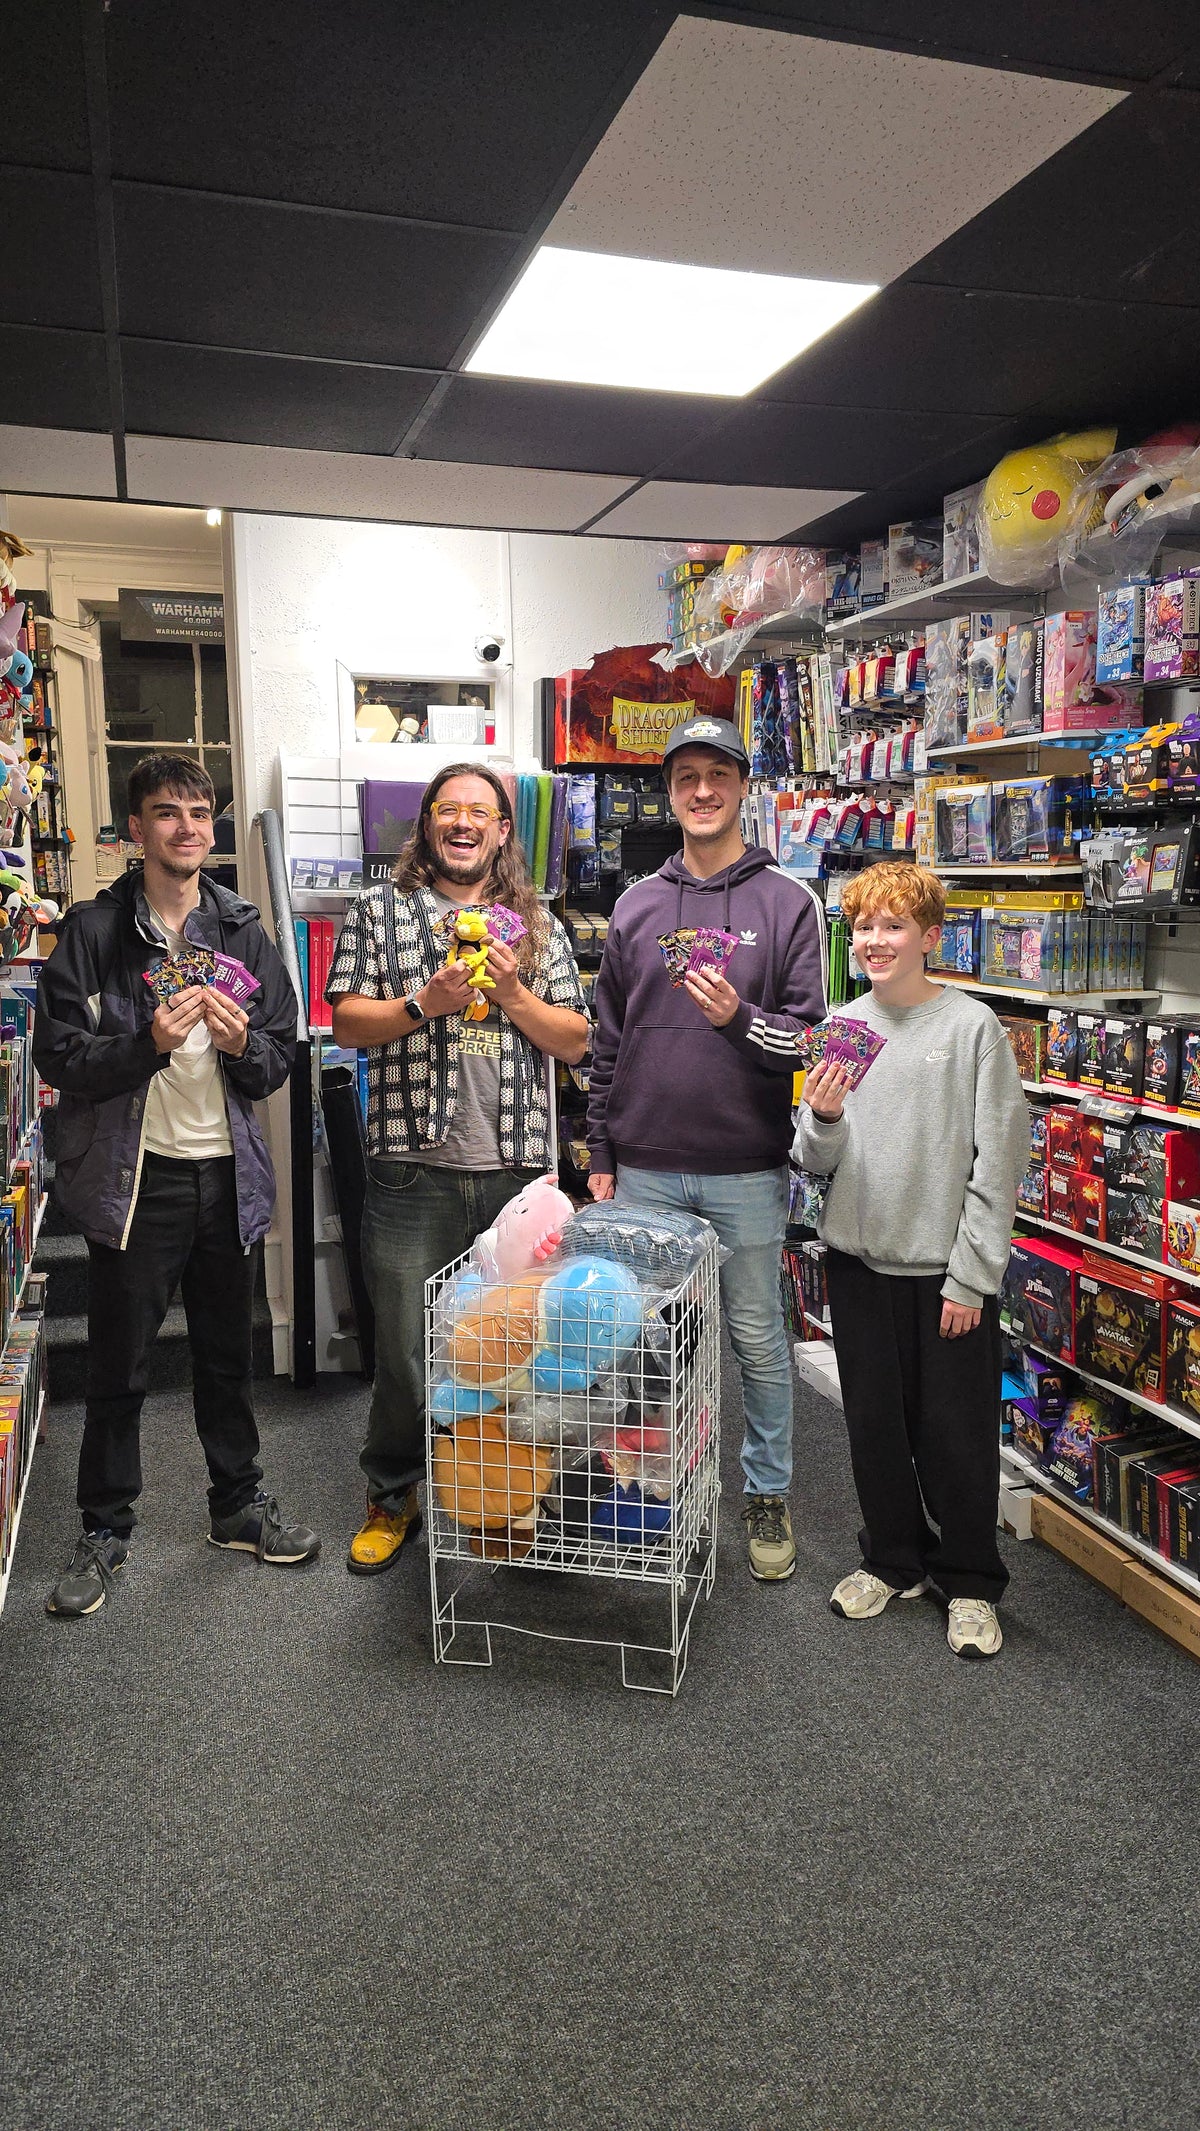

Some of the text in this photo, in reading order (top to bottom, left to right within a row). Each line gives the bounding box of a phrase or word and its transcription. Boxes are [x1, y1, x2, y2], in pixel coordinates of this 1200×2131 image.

[152, 603, 223, 618] WARHAMM
[1034, 630, 1043, 703] BORUTO UZUMAKI
[1161, 665, 1169, 675] 34
[619, 704, 691, 729] DRAGON
[930, 1049, 949, 1057] NIKE
[1110, 1127, 1126, 1135] MAGIC
[1053, 1151, 1077, 1163] AVATAR
[1181, 1258, 1195, 1272] SUPER
[1175, 1314, 1195, 1327] MAGIC
[1097, 1325, 1134, 1347] AVATAR
[1056, 1460, 1078, 1479] THE GREAT
[1063, 1473, 1079, 1488] RESCUE
[1141, 1484, 1149, 1535] SUPER HEROES
[1179, 1506, 1188, 1560] SUPER HEROES
